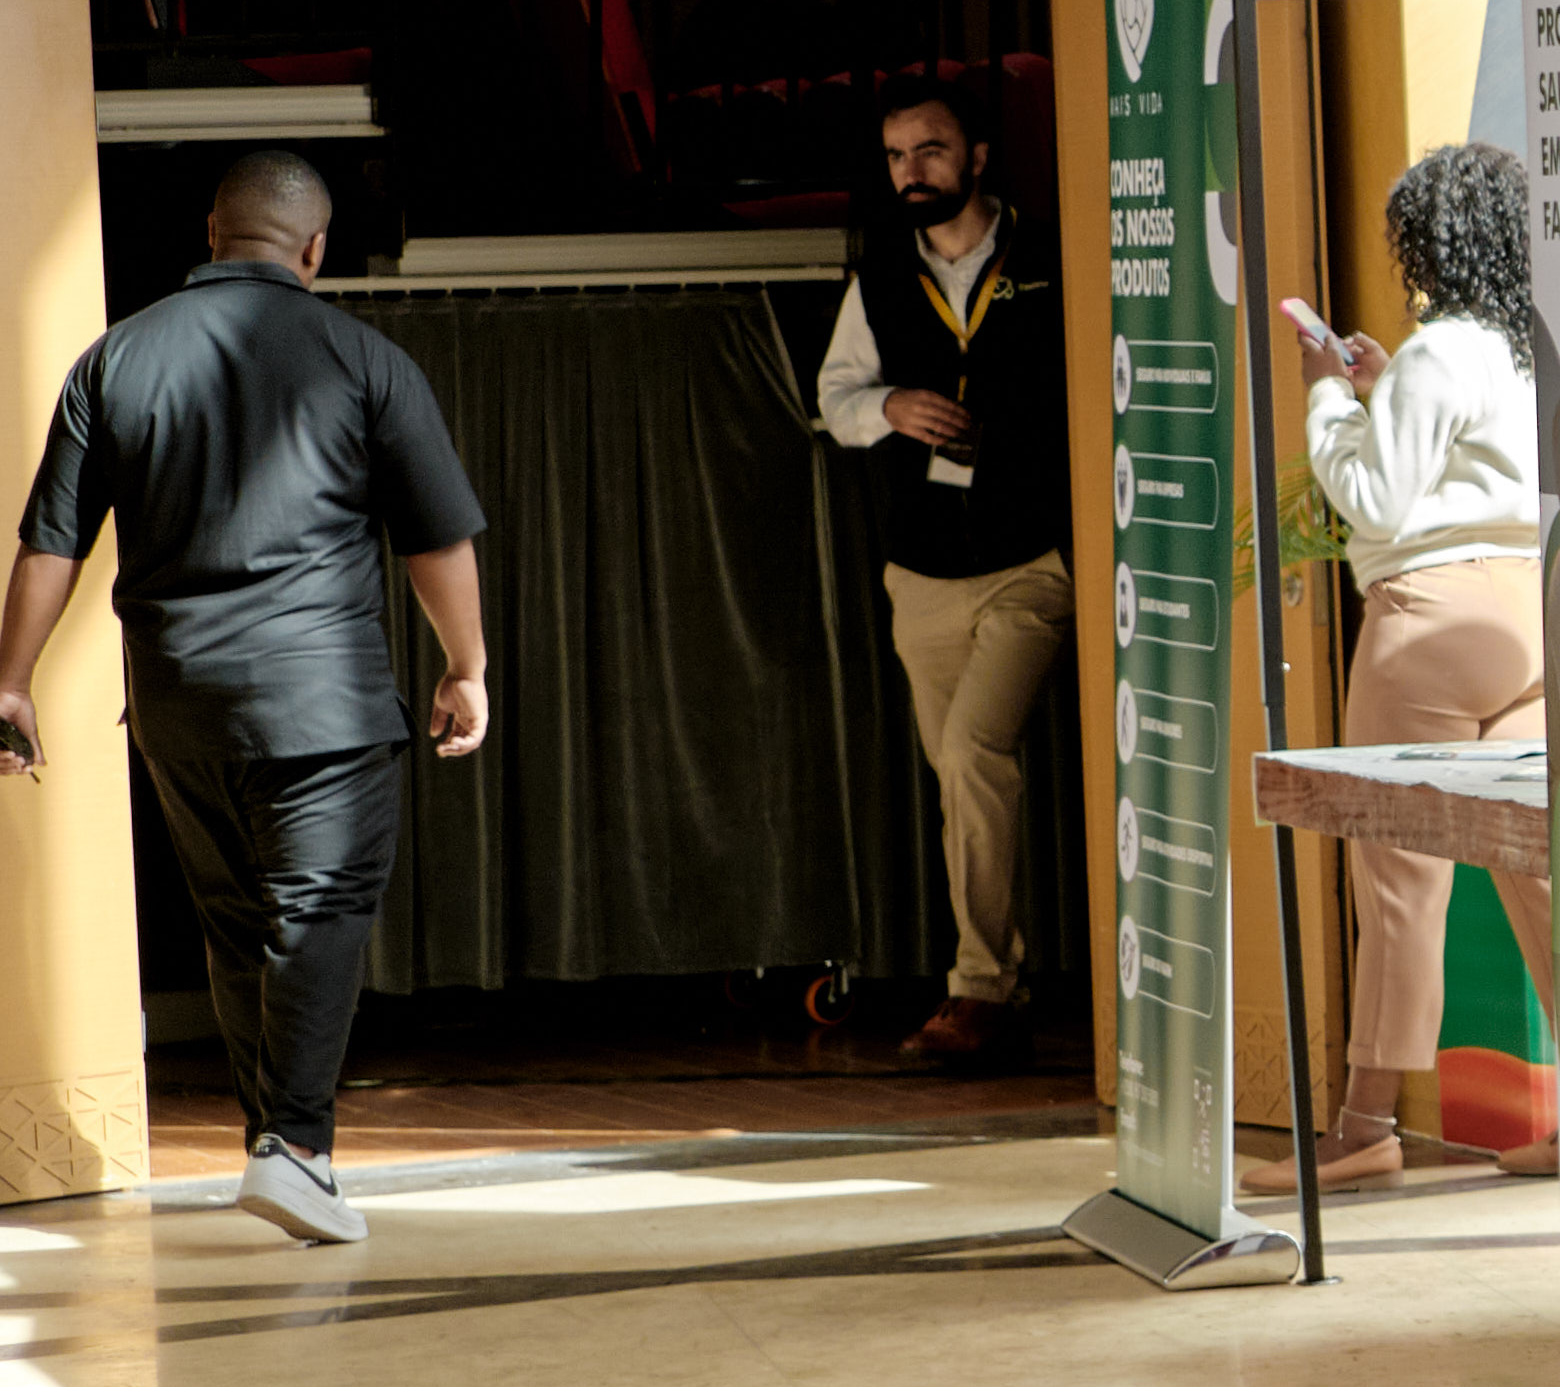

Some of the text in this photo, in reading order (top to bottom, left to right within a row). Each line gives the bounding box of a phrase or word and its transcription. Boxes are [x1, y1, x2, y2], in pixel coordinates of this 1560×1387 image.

[1138, 91, 1164, 115] VIDA
[1110, 157, 1166, 206] CONHEÇA
[1126, 206, 1175, 247] NOSSOS
[1111, 257, 1171, 297] PRODUTOS
